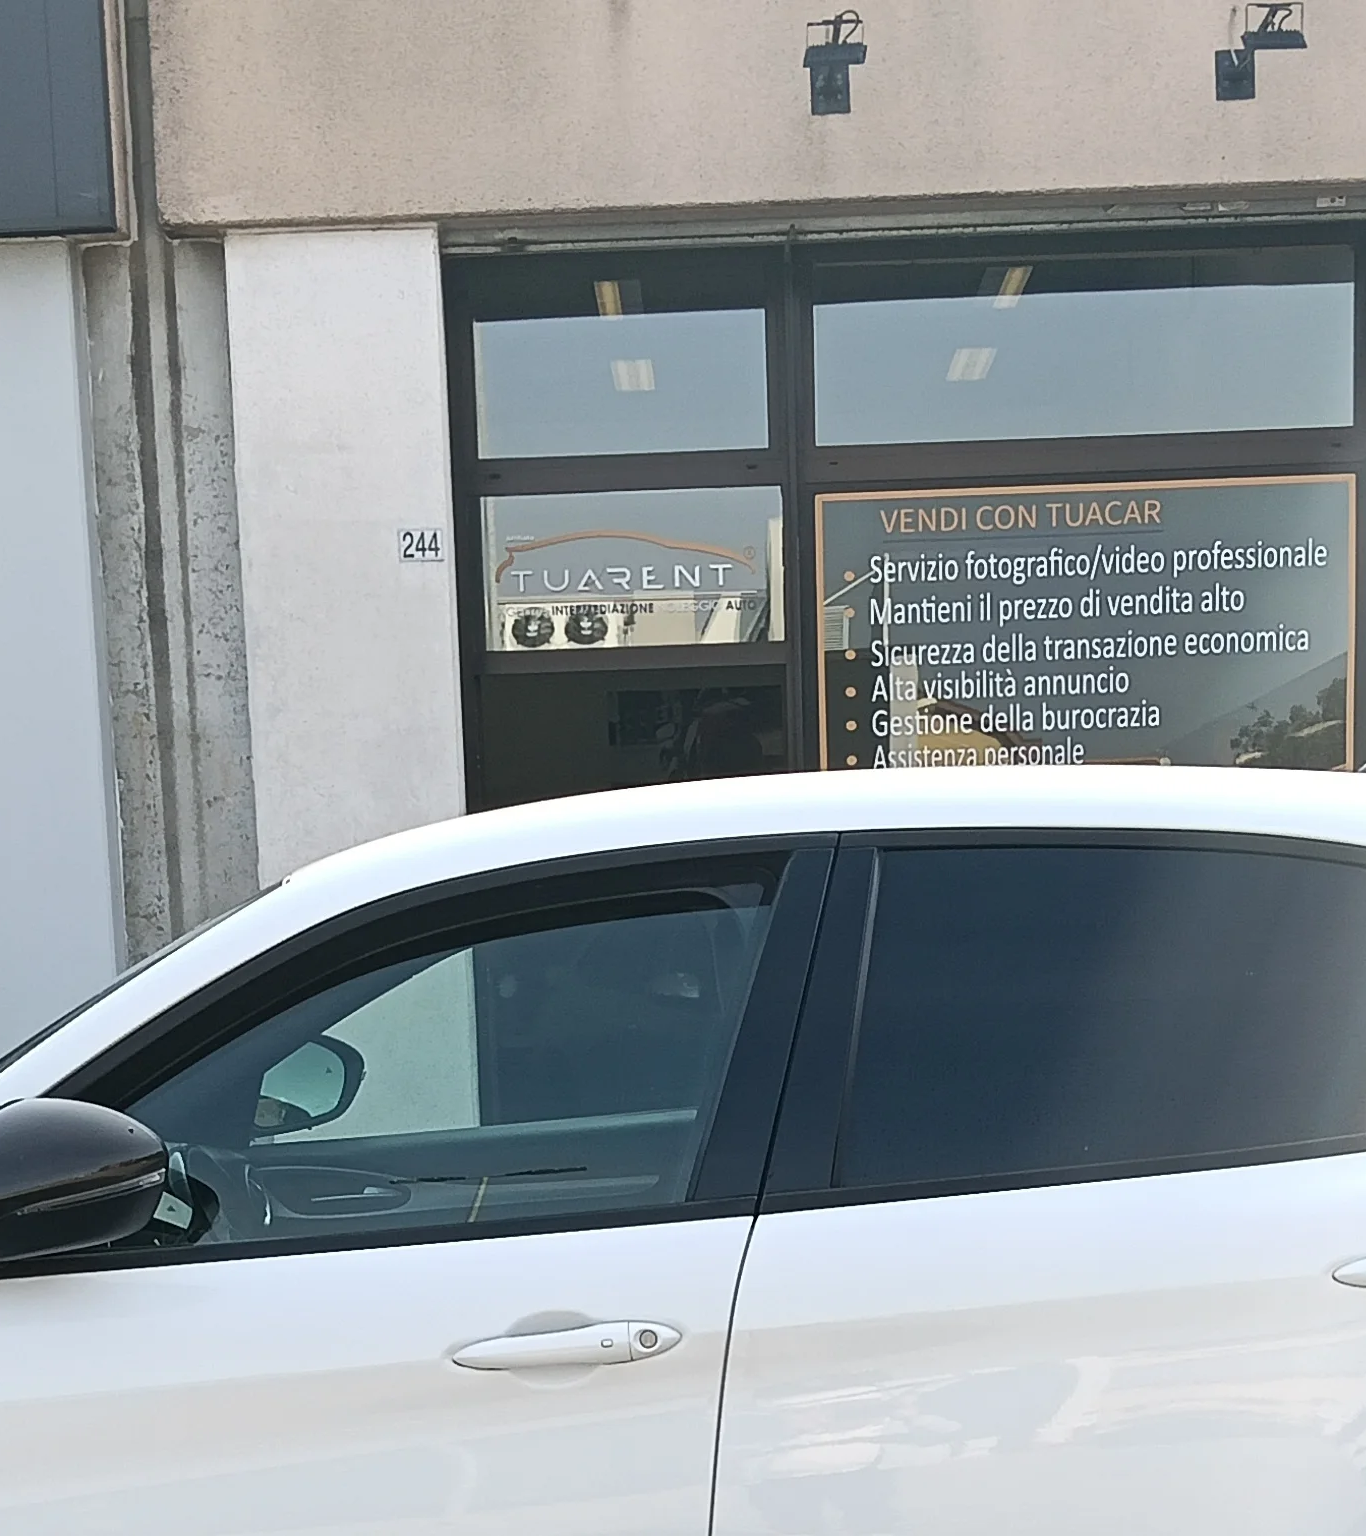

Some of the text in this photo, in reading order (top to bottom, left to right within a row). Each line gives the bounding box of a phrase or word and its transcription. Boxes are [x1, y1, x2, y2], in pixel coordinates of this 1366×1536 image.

[880, 498, 1162, 534] VENDI CON TUACAR
[402, 531, 441, 558] 244
[869, 538, 1328, 586] Servizio fotografico/video professionale
[511, 563, 733, 592] TUARENT
[869, 581, 1246, 628] Mantieni il prezzo di vendita alto
[870, 620, 1309, 669] Sicurezza della transazione economica
[871, 665, 1130, 703] Alta visibilità annuncio
[871, 699, 1161, 736] Gestione della burocrazia
